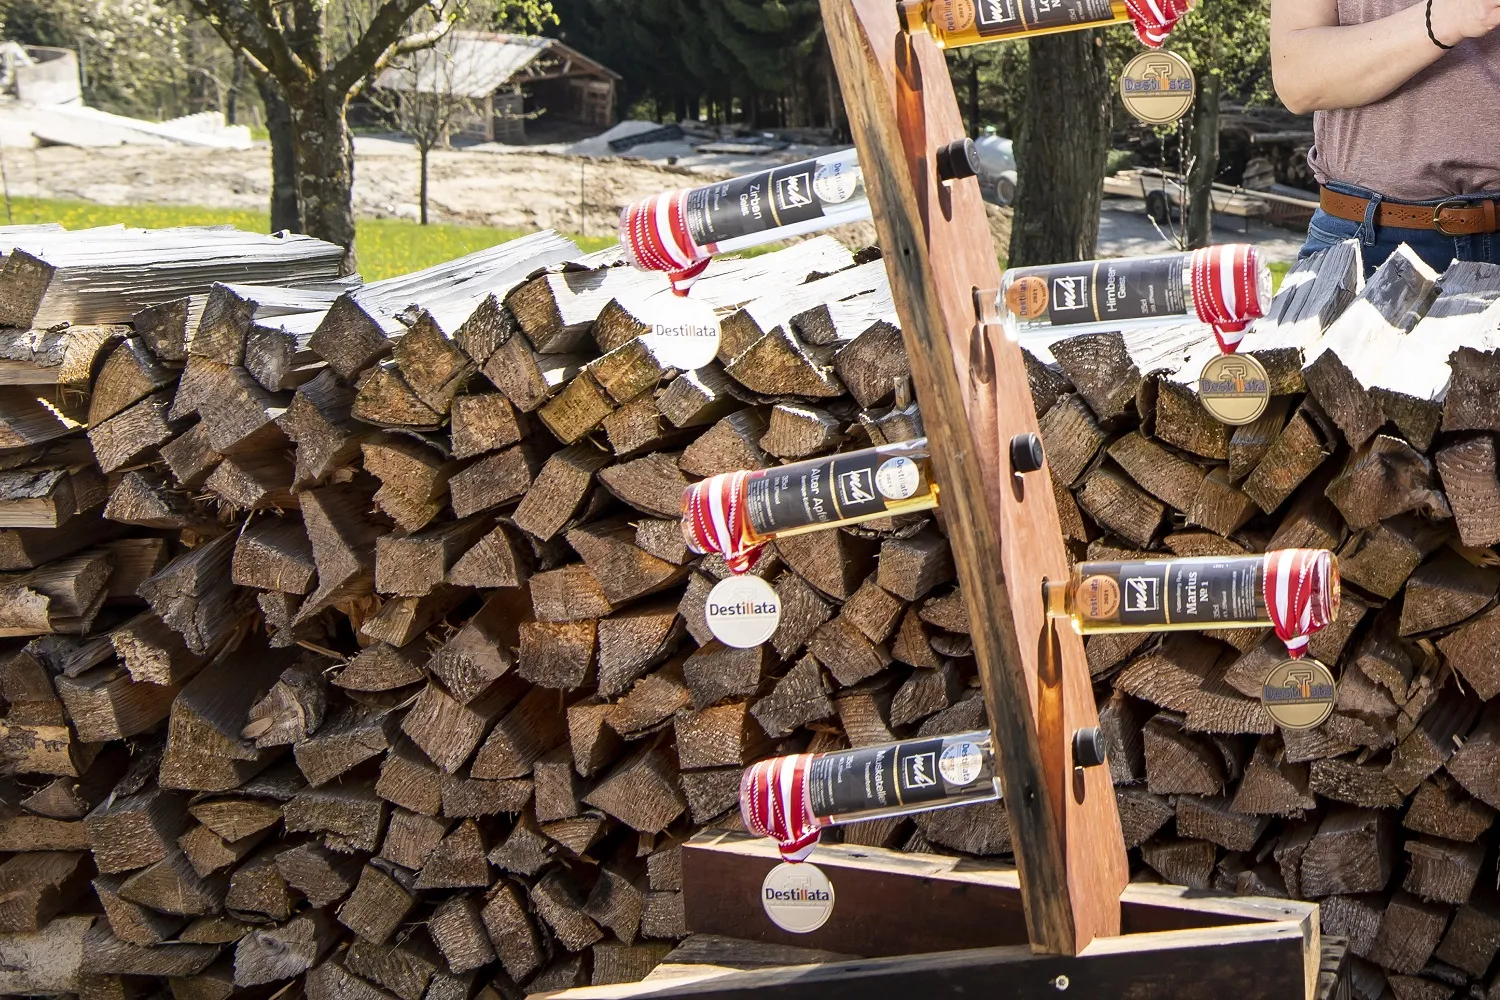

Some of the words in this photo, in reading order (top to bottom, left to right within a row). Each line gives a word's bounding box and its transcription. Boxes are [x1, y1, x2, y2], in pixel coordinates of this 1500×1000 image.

[1124, 76, 1191, 91] Destillata
[740, 194, 749, 216] Geist
[750, 184, 762, 219] Zirben
[1016, 279, 1029, 315] Destillata
[1106, 267, 1117, 311] Himbeer
[1118, 276, 1126, 298] Geist
[1140, 299, 1149, 313] 35cl
[656, 324, 717, 337] Destillata
[1202, 379, 1265, 393] Destillata
[811, 469, 820, 494] Alter
[1087, 578, 1100, 615] Destillata
[1186, 572, 1197, 614] Marius
[709, 601, 777, 616] Destillata
[1265, 684, 1332, 700] Destillata
[957, 743, 975, 781] Destillata
[861, 761, 876, 798] Tresterbrand
[874, 750, 887, 806] Muskateller
[765, 887, 830, 901] Destillata
